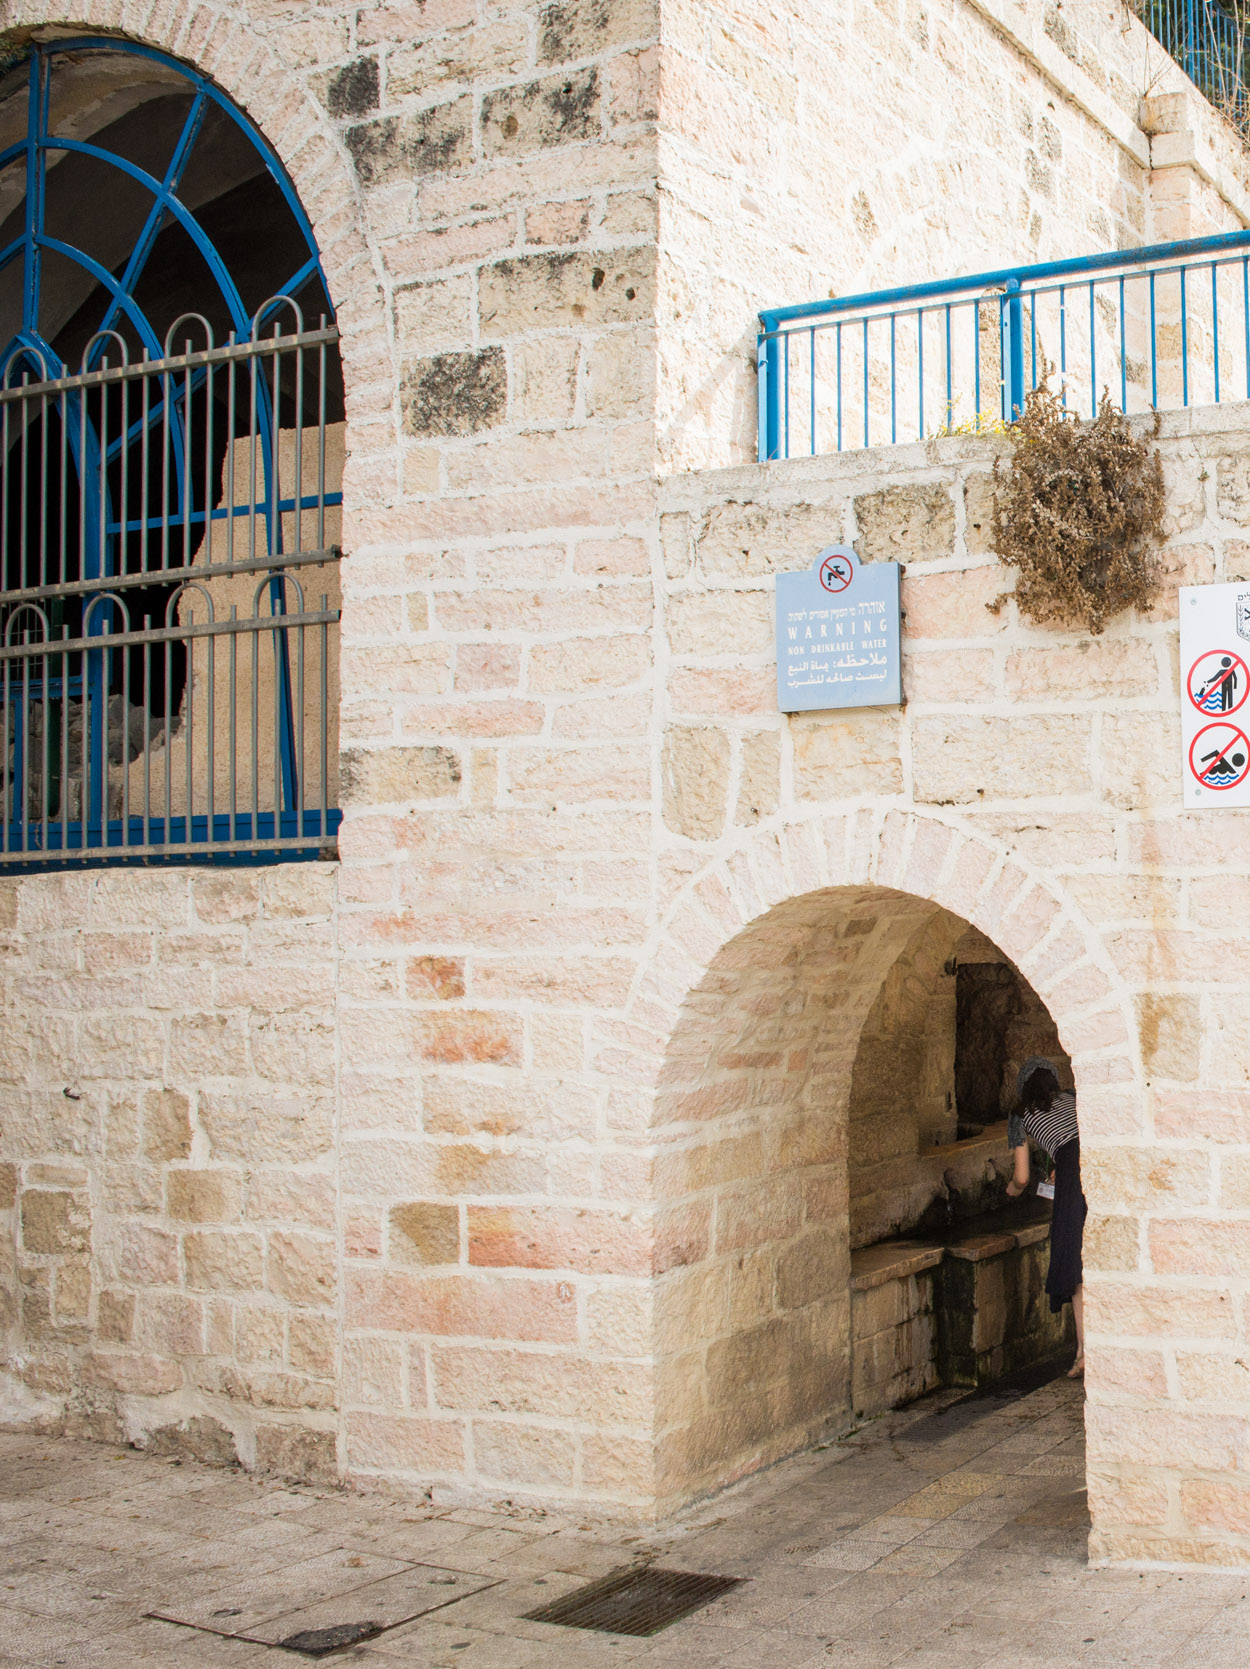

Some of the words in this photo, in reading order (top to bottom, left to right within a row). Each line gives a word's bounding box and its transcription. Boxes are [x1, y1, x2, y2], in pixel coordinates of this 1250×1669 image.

[787, 618, 887, 640] WARNING
[788, 645, 805, 656] NON
[810, 640, 855, 653] DRINKABLE
[861, 638, 888, 649] WATER
